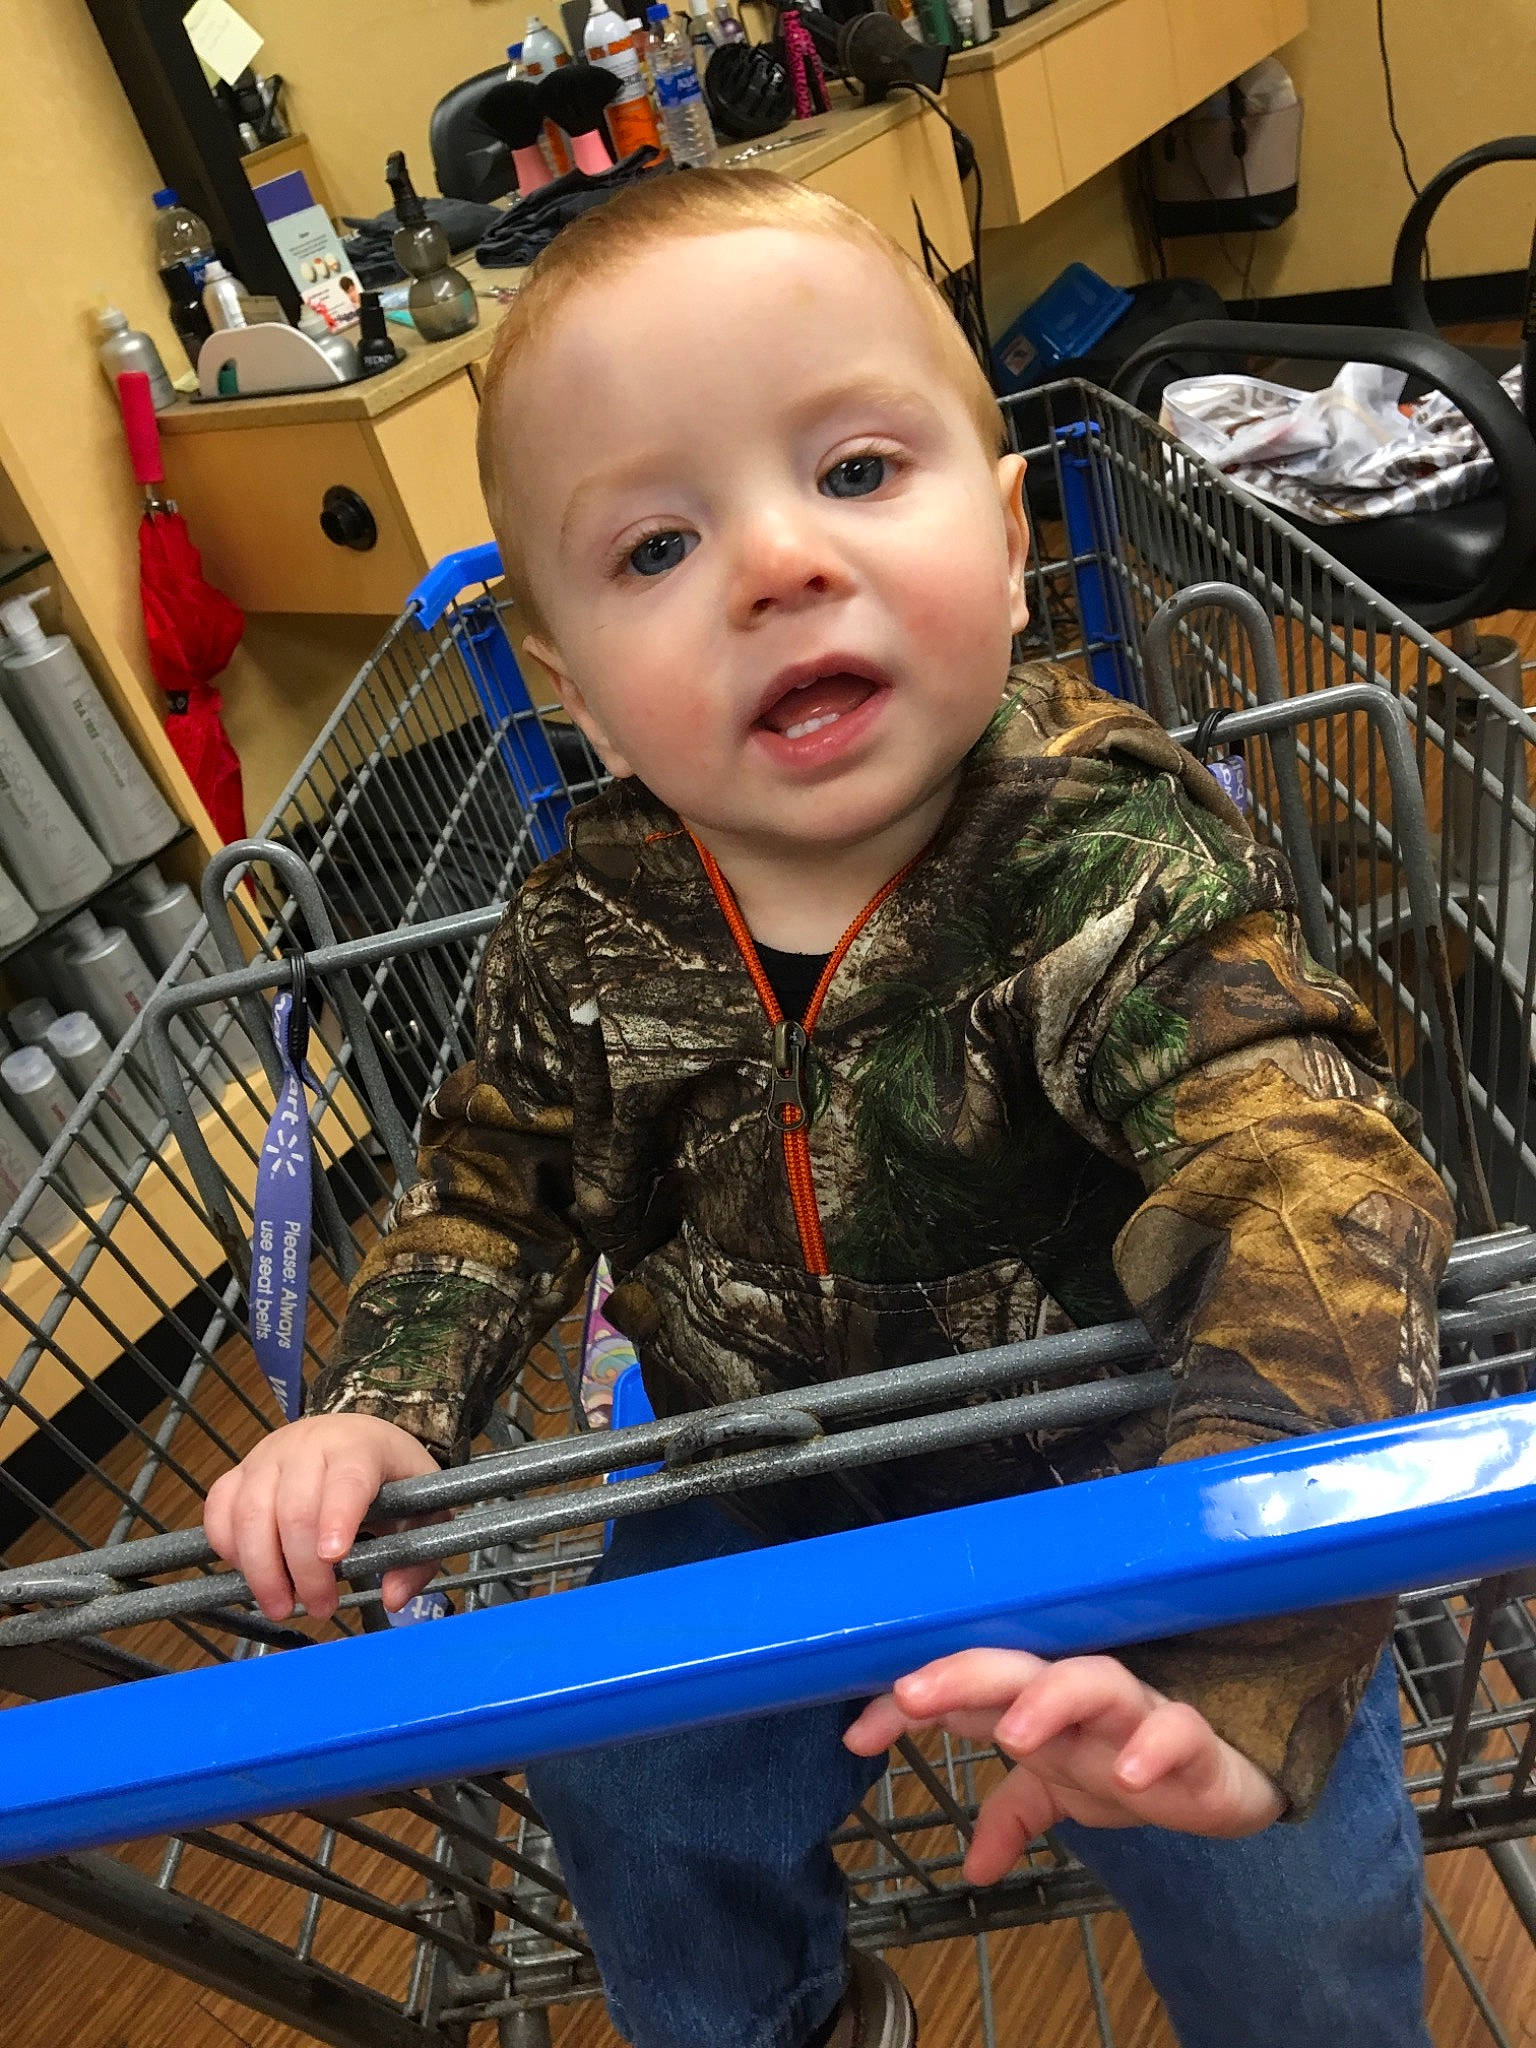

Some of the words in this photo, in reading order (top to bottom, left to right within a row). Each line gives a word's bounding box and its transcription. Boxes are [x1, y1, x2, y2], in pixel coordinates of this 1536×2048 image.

[259, 1219, 274, 1252] use
[281, 1220, 301, 1284] Please:
[256, 1254, 274, 1295] seat
[255, 1297, 273, 1342] belts.
[277, 1286, 298, 1350] Always
